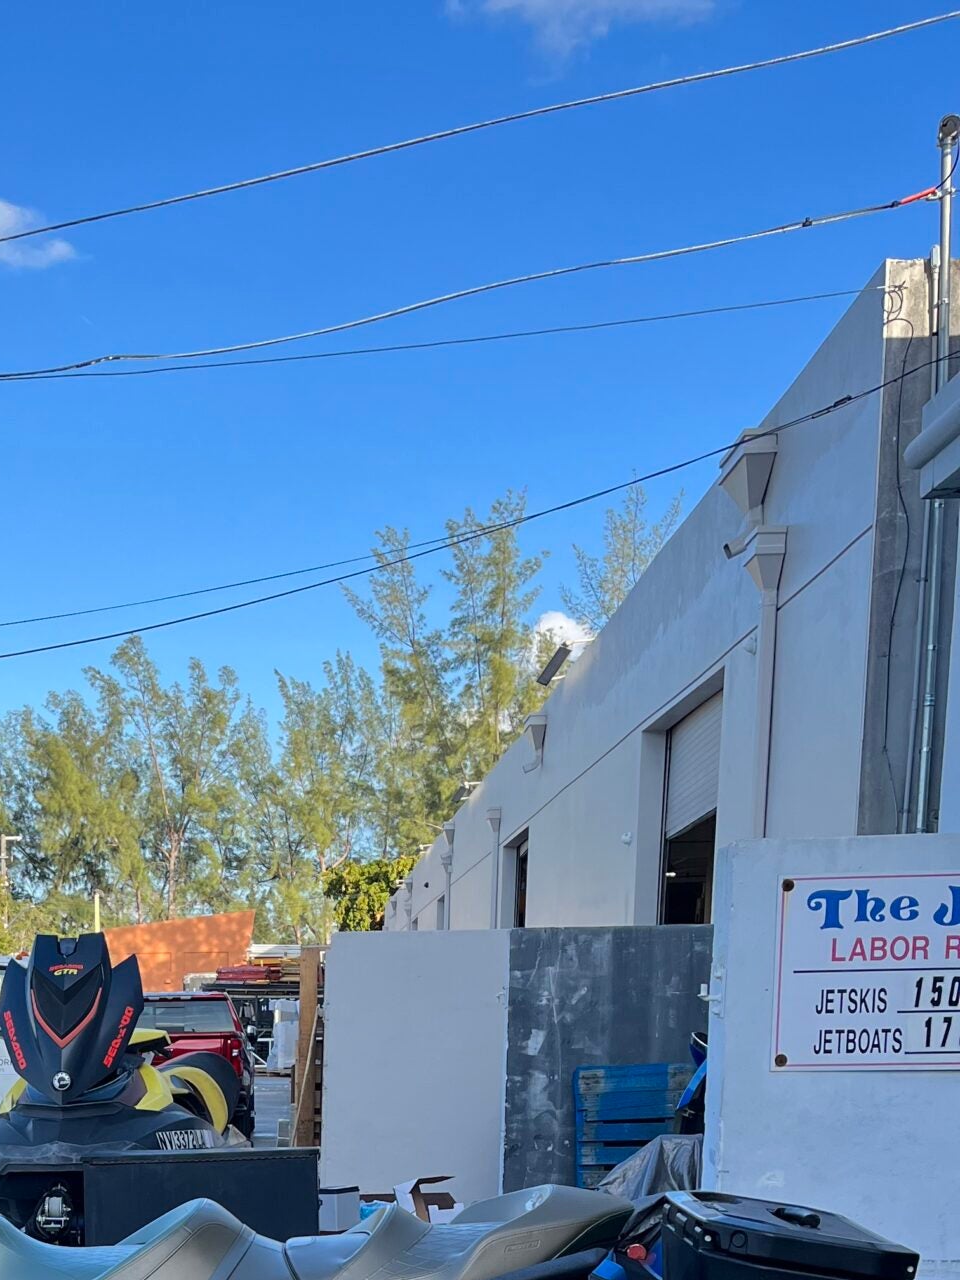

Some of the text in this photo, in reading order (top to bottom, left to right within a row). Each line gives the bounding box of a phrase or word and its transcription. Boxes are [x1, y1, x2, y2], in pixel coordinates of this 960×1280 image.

[806, 888, 920, 930] The
[831, 935, 930, 962] LABOR
[815, 976, 960, 1015] JETSKIS 150
[813, 1016, 960, 1055] JETBOATS 17
